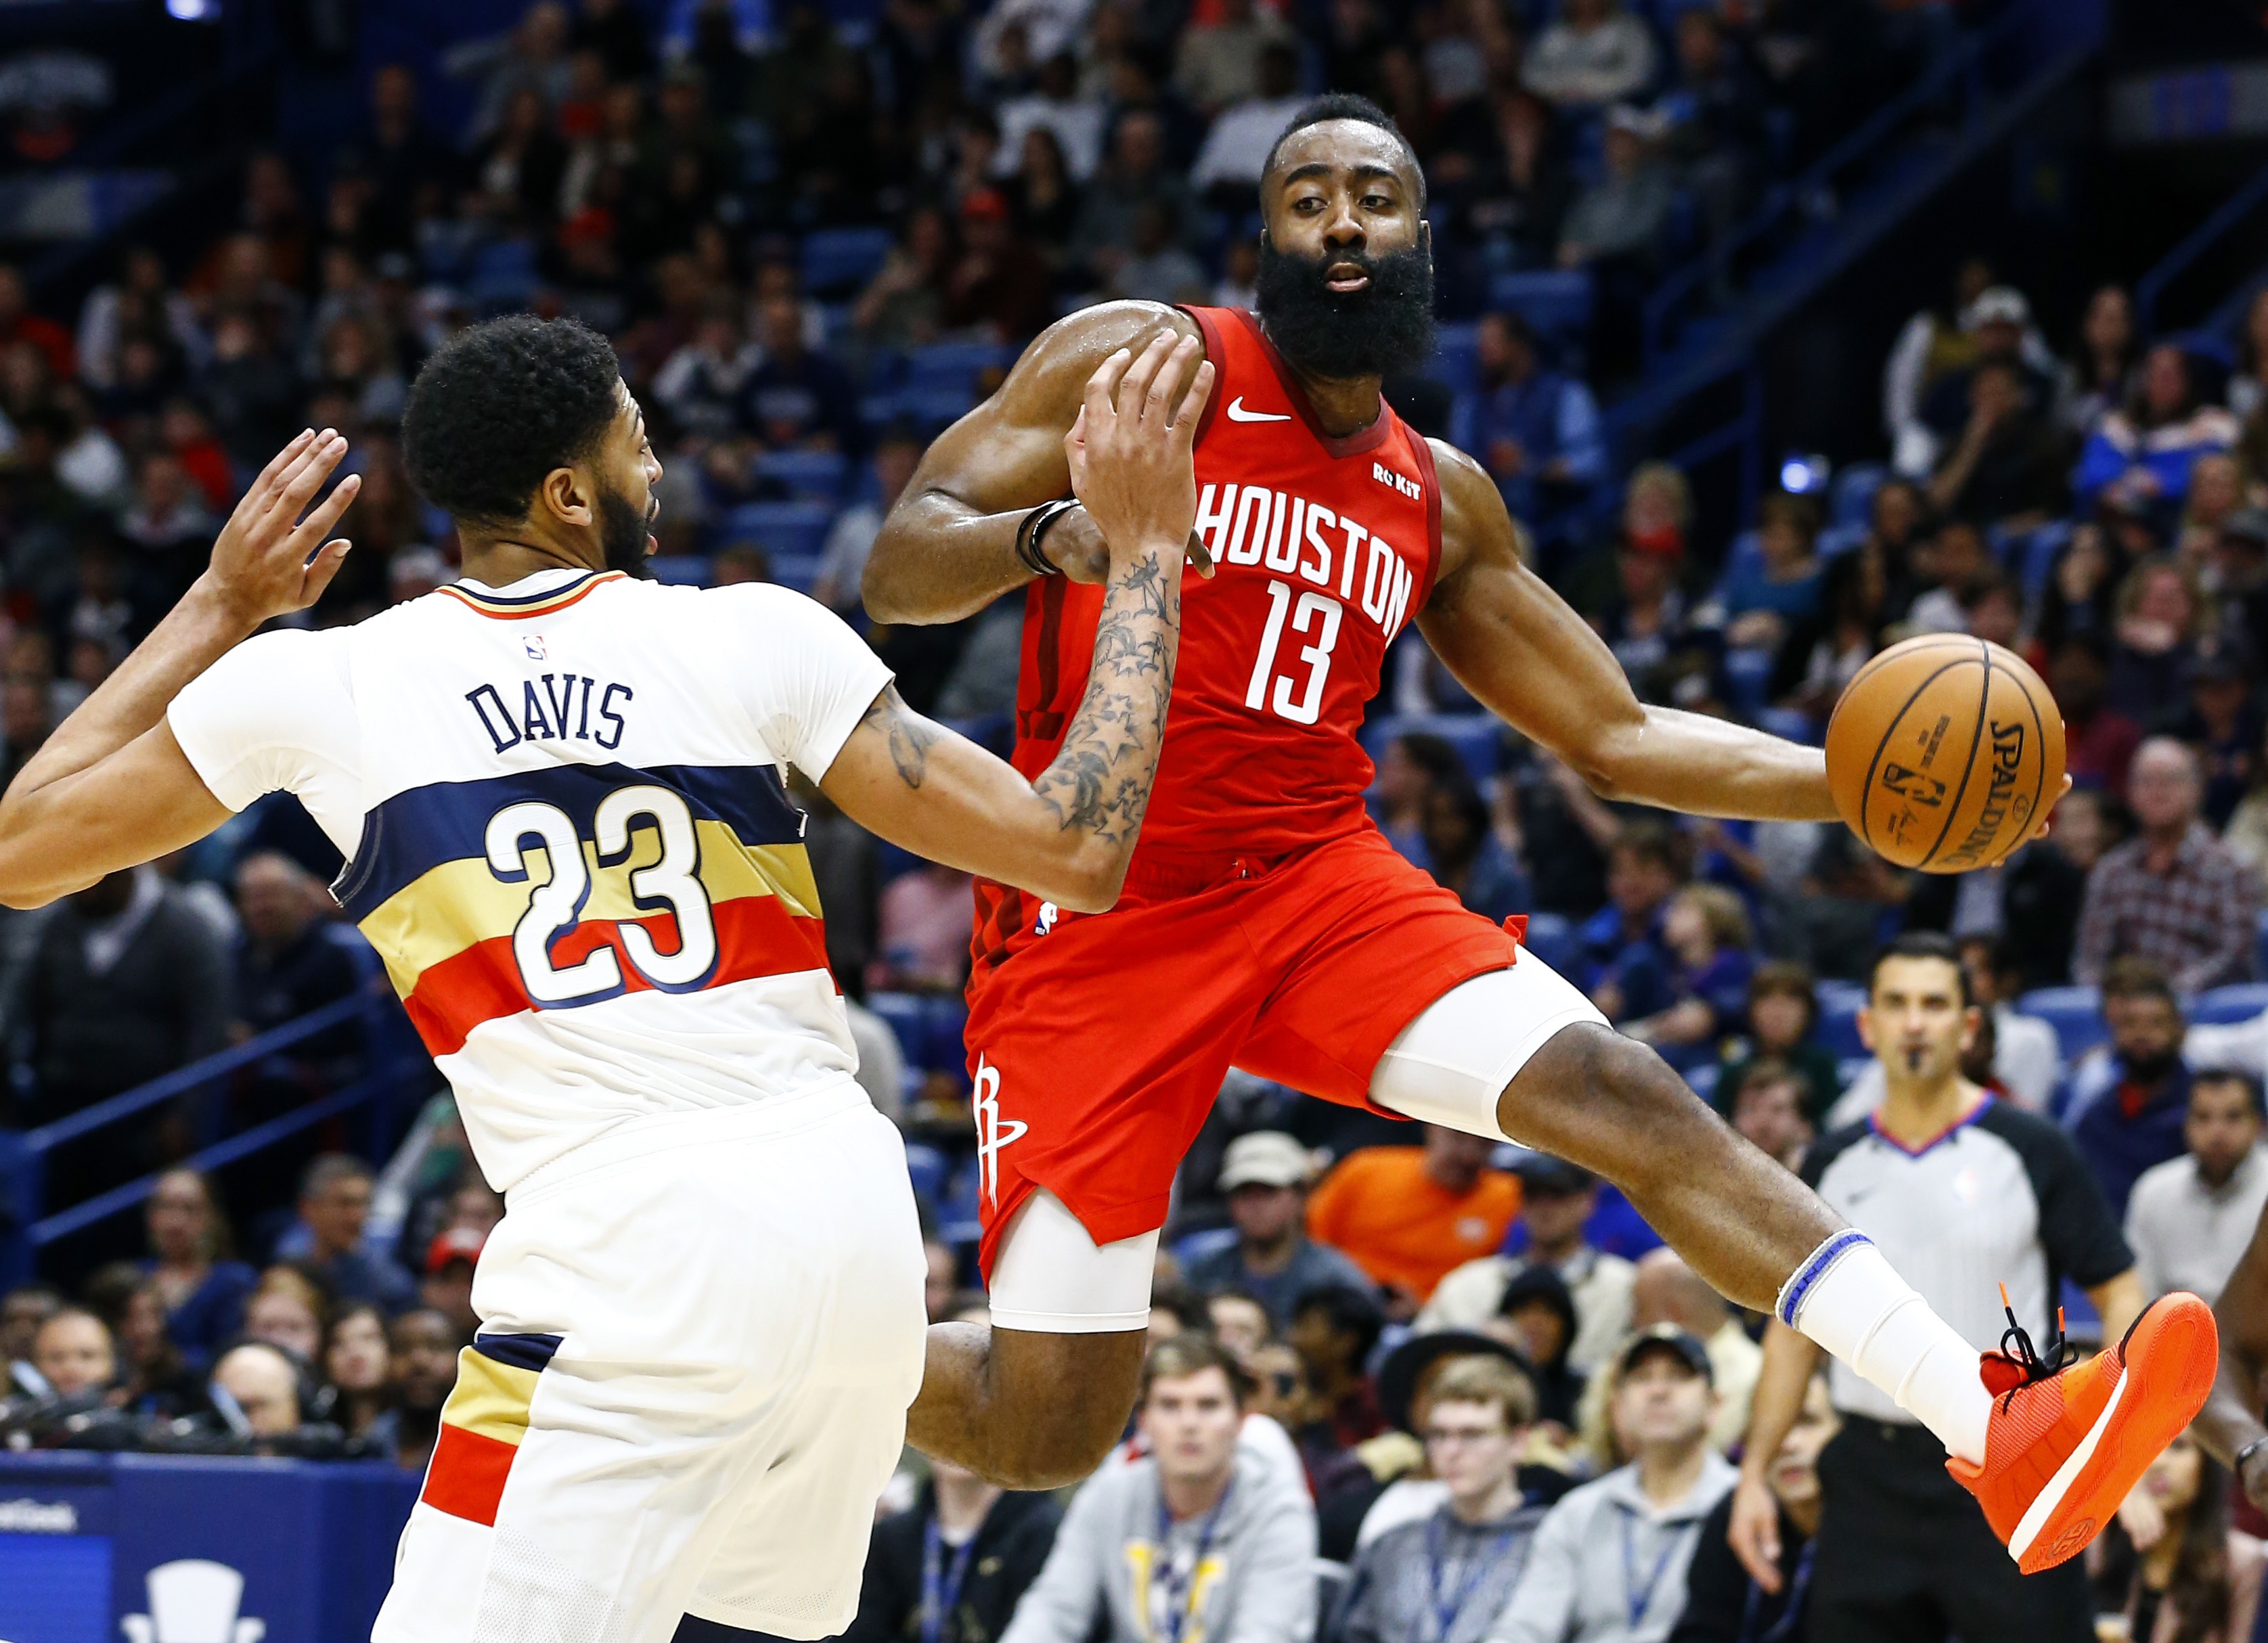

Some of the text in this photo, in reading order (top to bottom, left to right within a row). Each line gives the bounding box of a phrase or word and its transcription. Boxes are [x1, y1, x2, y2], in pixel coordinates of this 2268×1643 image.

[1186, 482, 1413, 648] HOUSTON
[464, 673, 633, 754] DAVIS
[1245, 579, 1343, 725] 13
[483, 784, 721, 1010] 23
